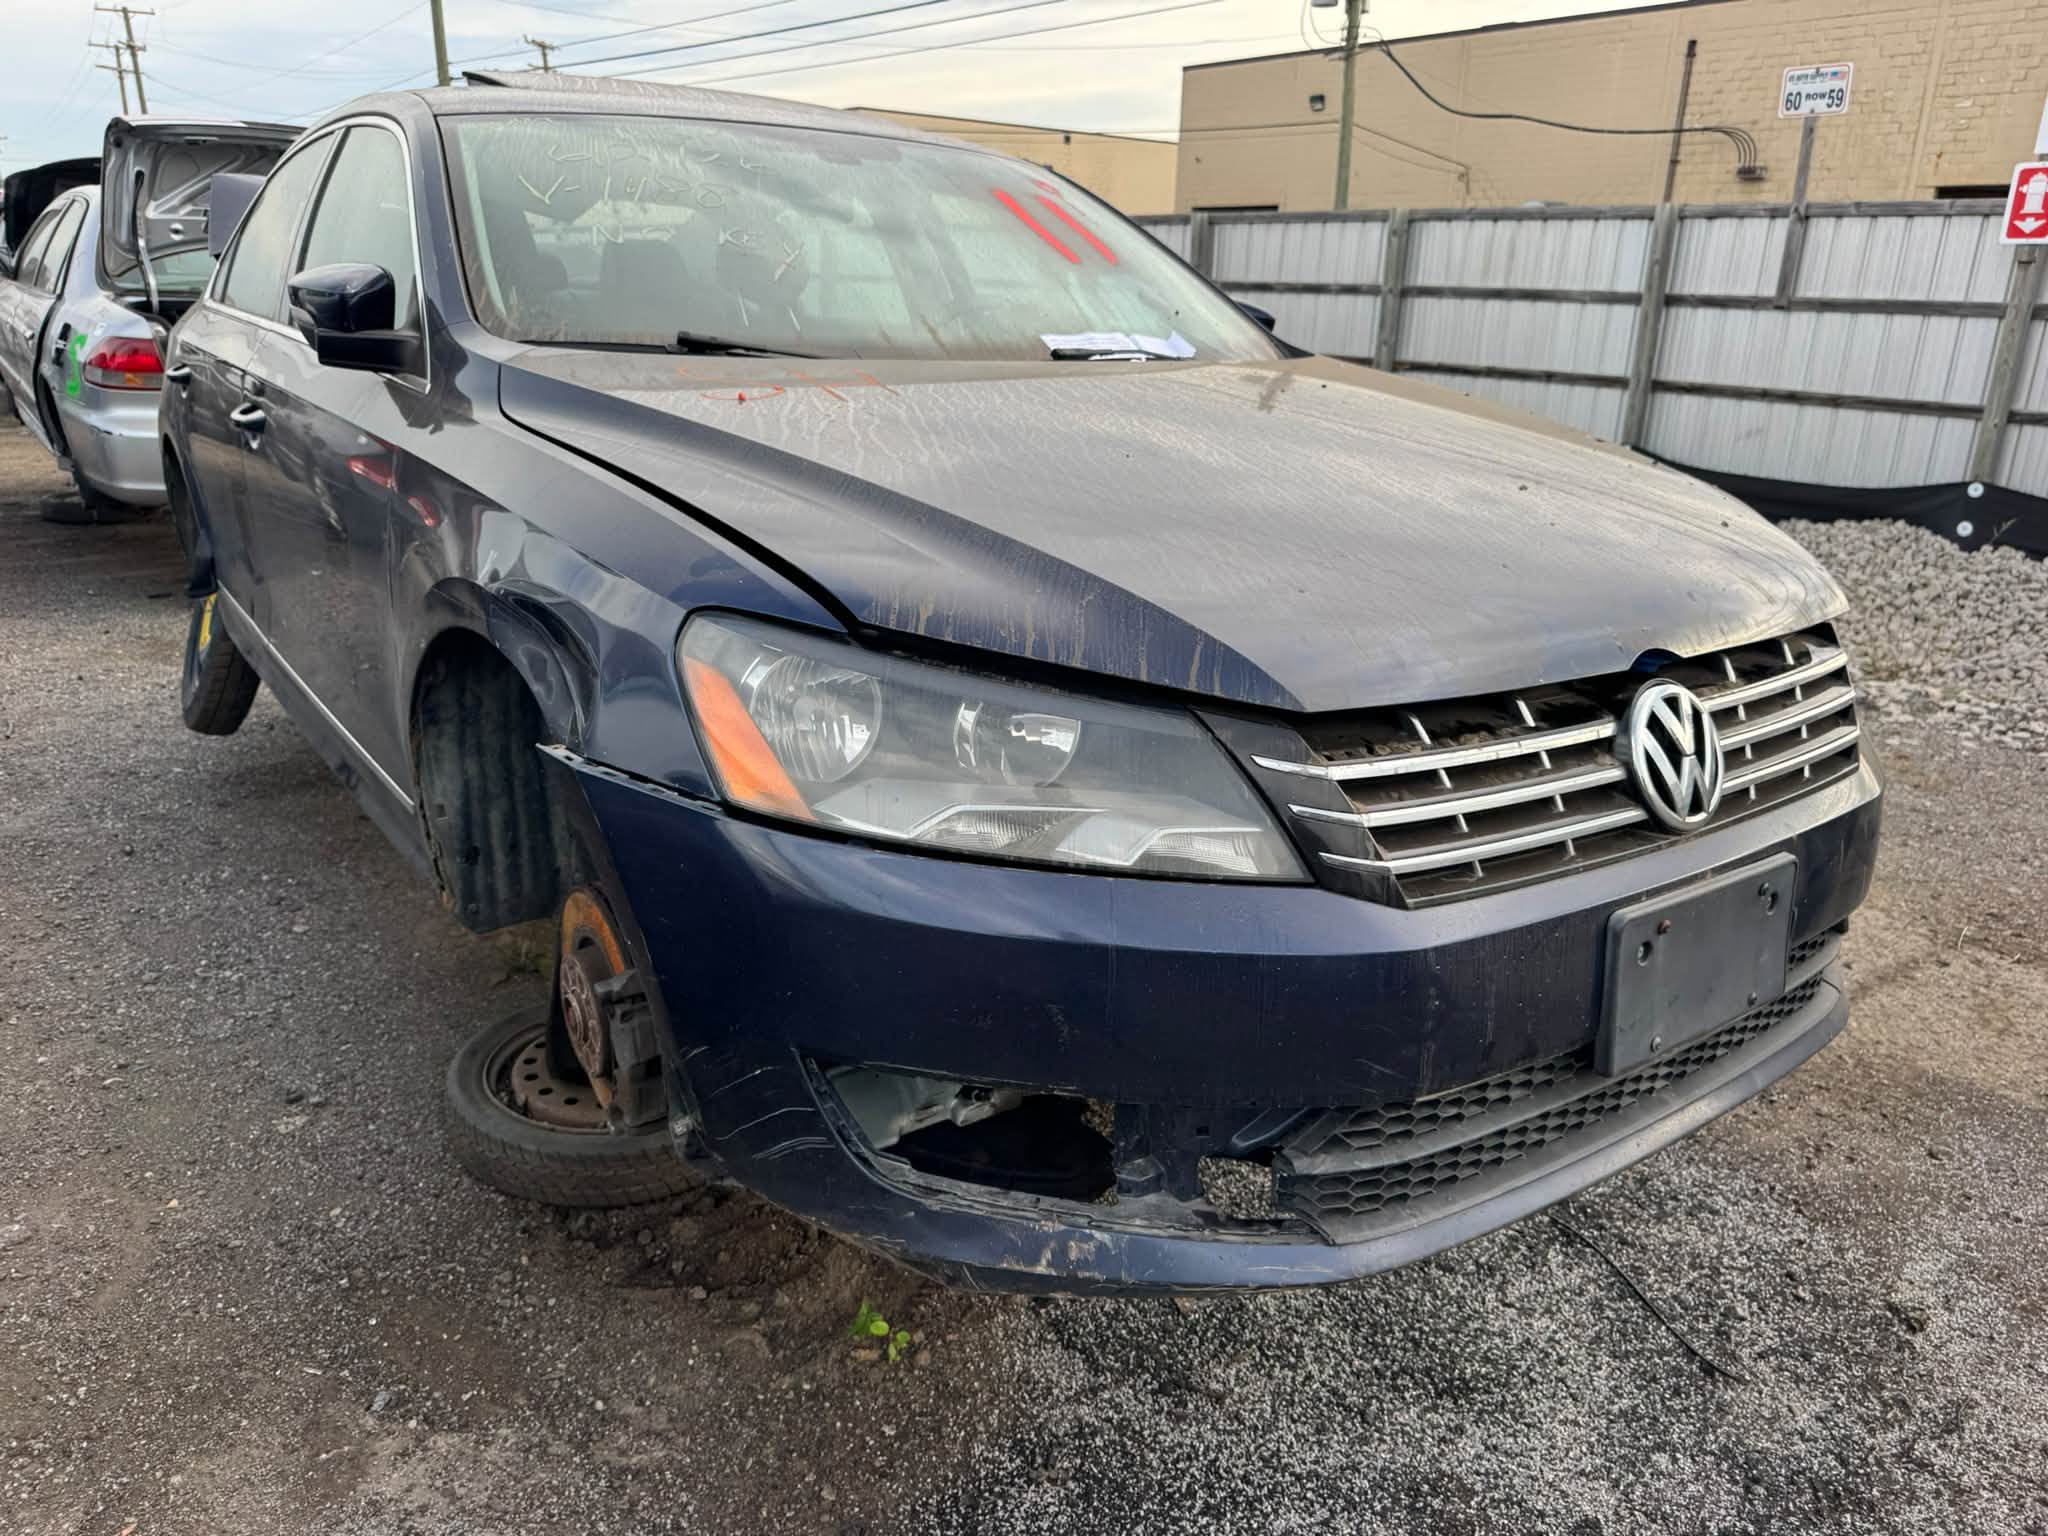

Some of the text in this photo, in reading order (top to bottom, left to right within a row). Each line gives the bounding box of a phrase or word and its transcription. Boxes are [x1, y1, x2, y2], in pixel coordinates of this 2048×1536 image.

[1785, 91, 1802, 111] 60
[1826, 87, 1845, 108] 59
[1631, 679, 1725, 832] VW
